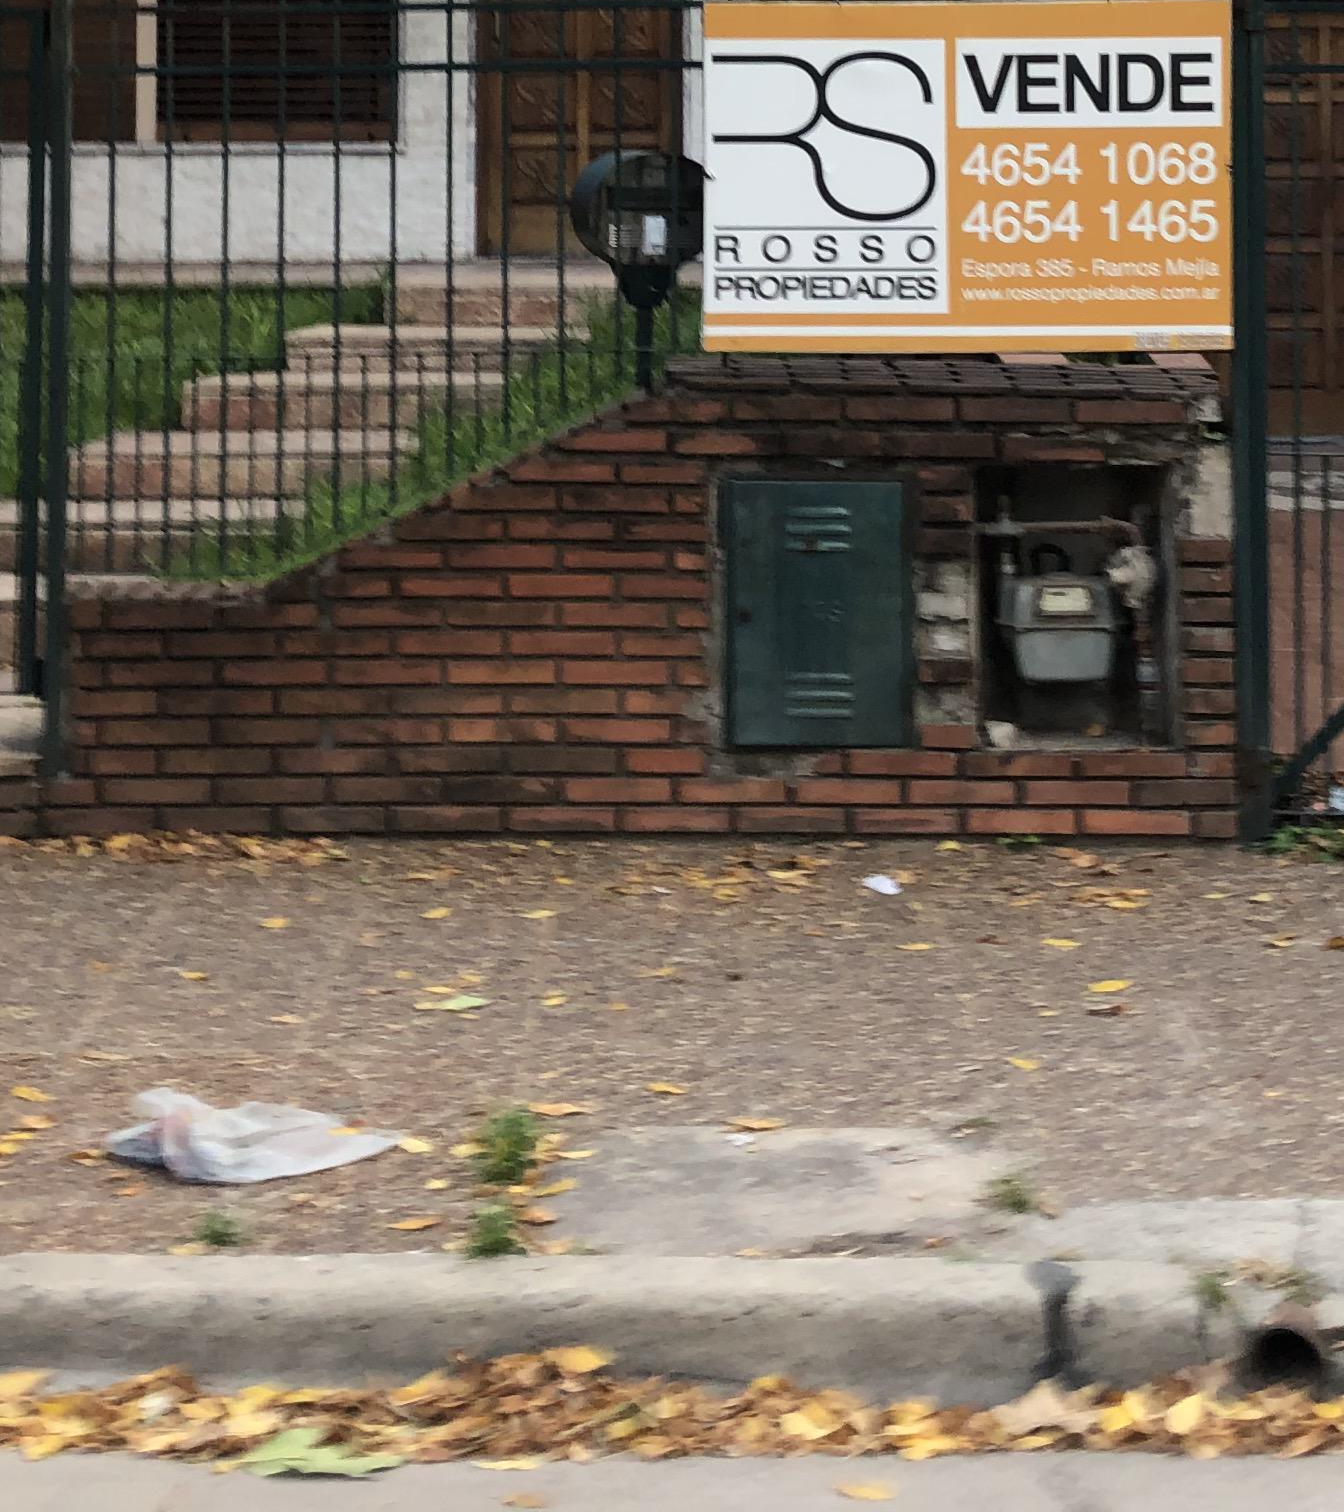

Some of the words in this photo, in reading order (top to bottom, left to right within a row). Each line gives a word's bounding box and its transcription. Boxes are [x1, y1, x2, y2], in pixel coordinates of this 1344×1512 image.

[963, 52, 1214, 114] VENDE
[960, 141, 1083, 186] 4654
[1099, 141, 1218, 186] 1068
[961, 199, 1084, 244] 4654
[1100, 199, 1219, 243] 1465
[714, 234, 937, 263] ROSSO
[961, 258, 1033, 281] Espora
[1091, 257, 1161, 278] Ramos
[714, 275, 938, 300] PROPIEDADES
[960, 284, 1221, 304] www.rossopropiedades.com.ar
